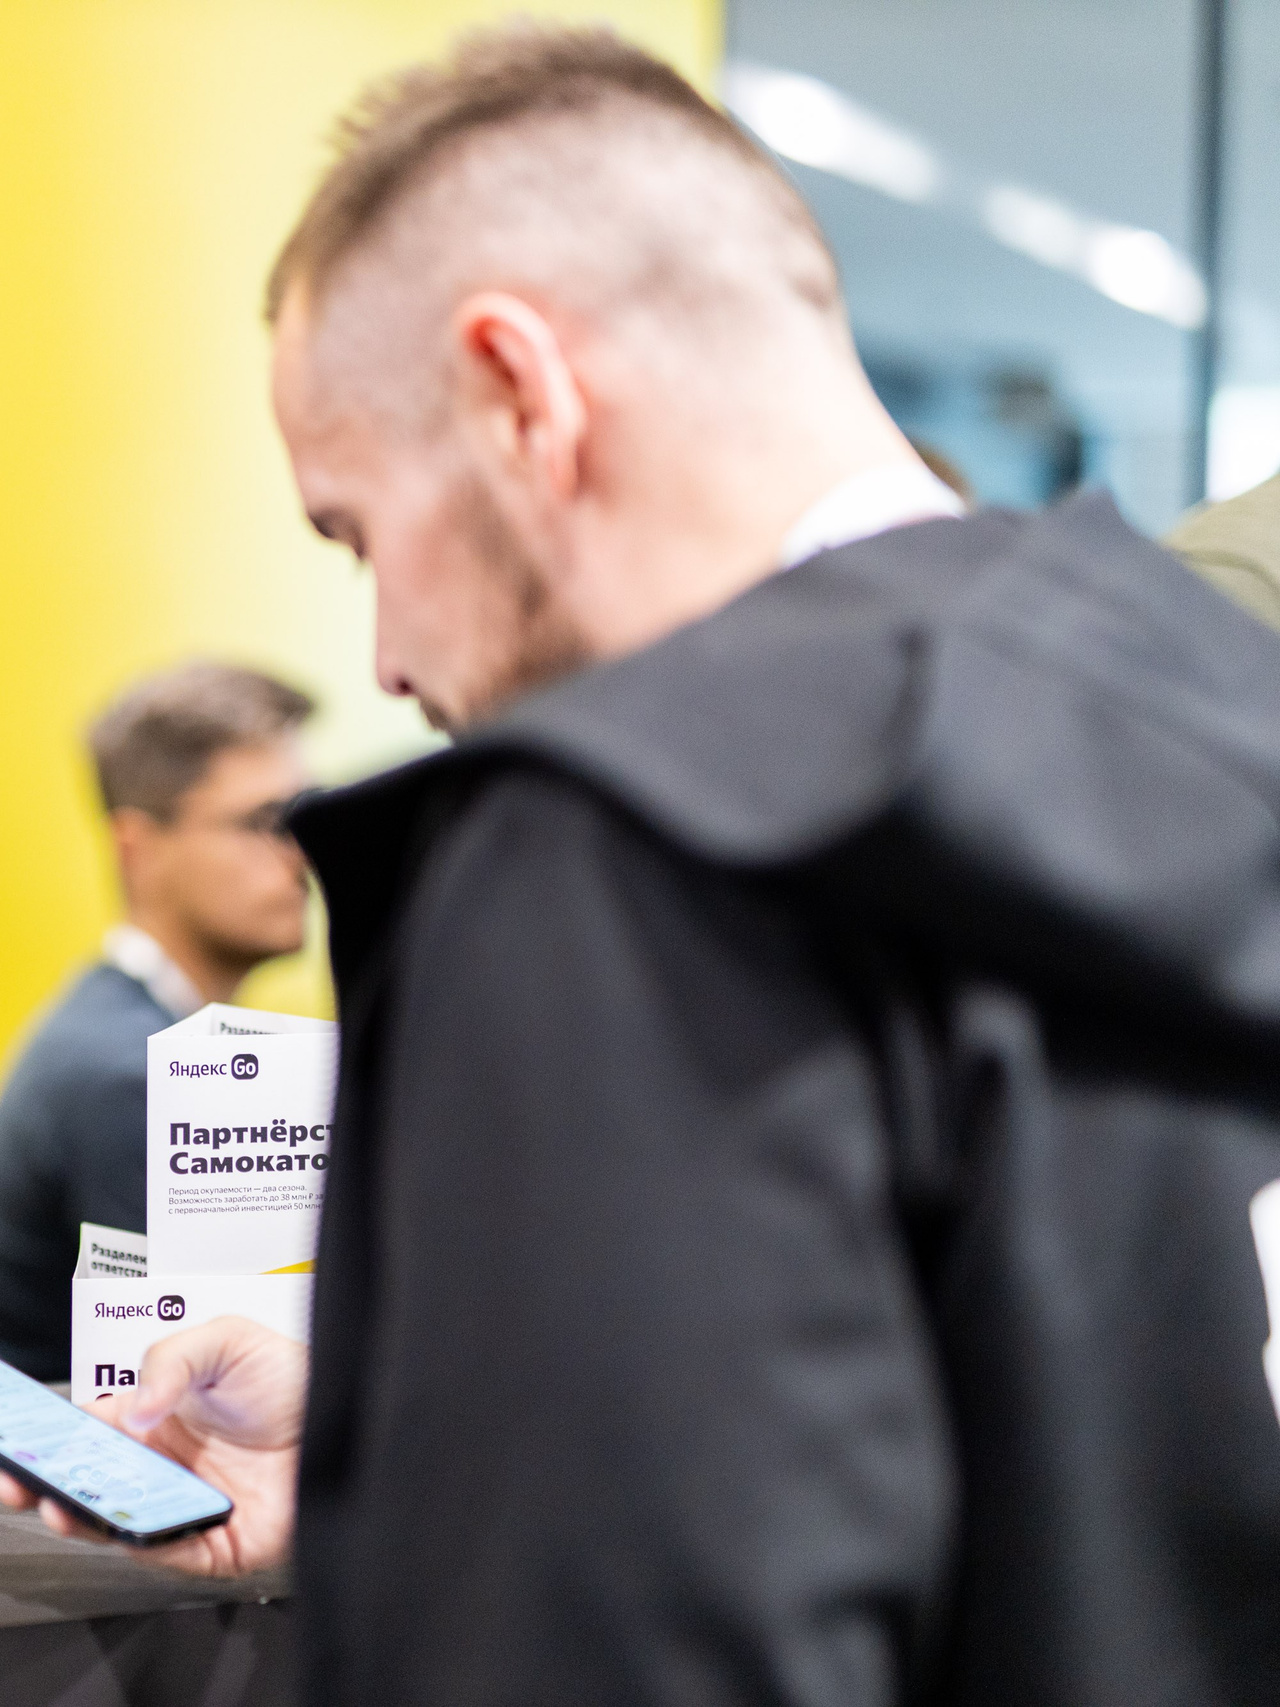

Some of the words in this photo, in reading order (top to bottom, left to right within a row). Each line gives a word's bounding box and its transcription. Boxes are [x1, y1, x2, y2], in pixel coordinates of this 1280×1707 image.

[169, 1061, 227, 1078] Яндекс
[233, 1057, 257, 1077] Go
[168, 1188, 199, 1196] Период
[200, 1187, 252, 1195] окупаемости
[278, 1184, 307, 1192] сезона.
[168, 1196, 223, 1205] Возможность
[224, 1194, 268, 1204] заработать
[174, 1205, 240, 1215] первоначальной
[241, 1203, 293, 1212] инвестицией
[94, 1303, 153, 1319] Яндекс
[159, 1299, 184, 1317] Go
